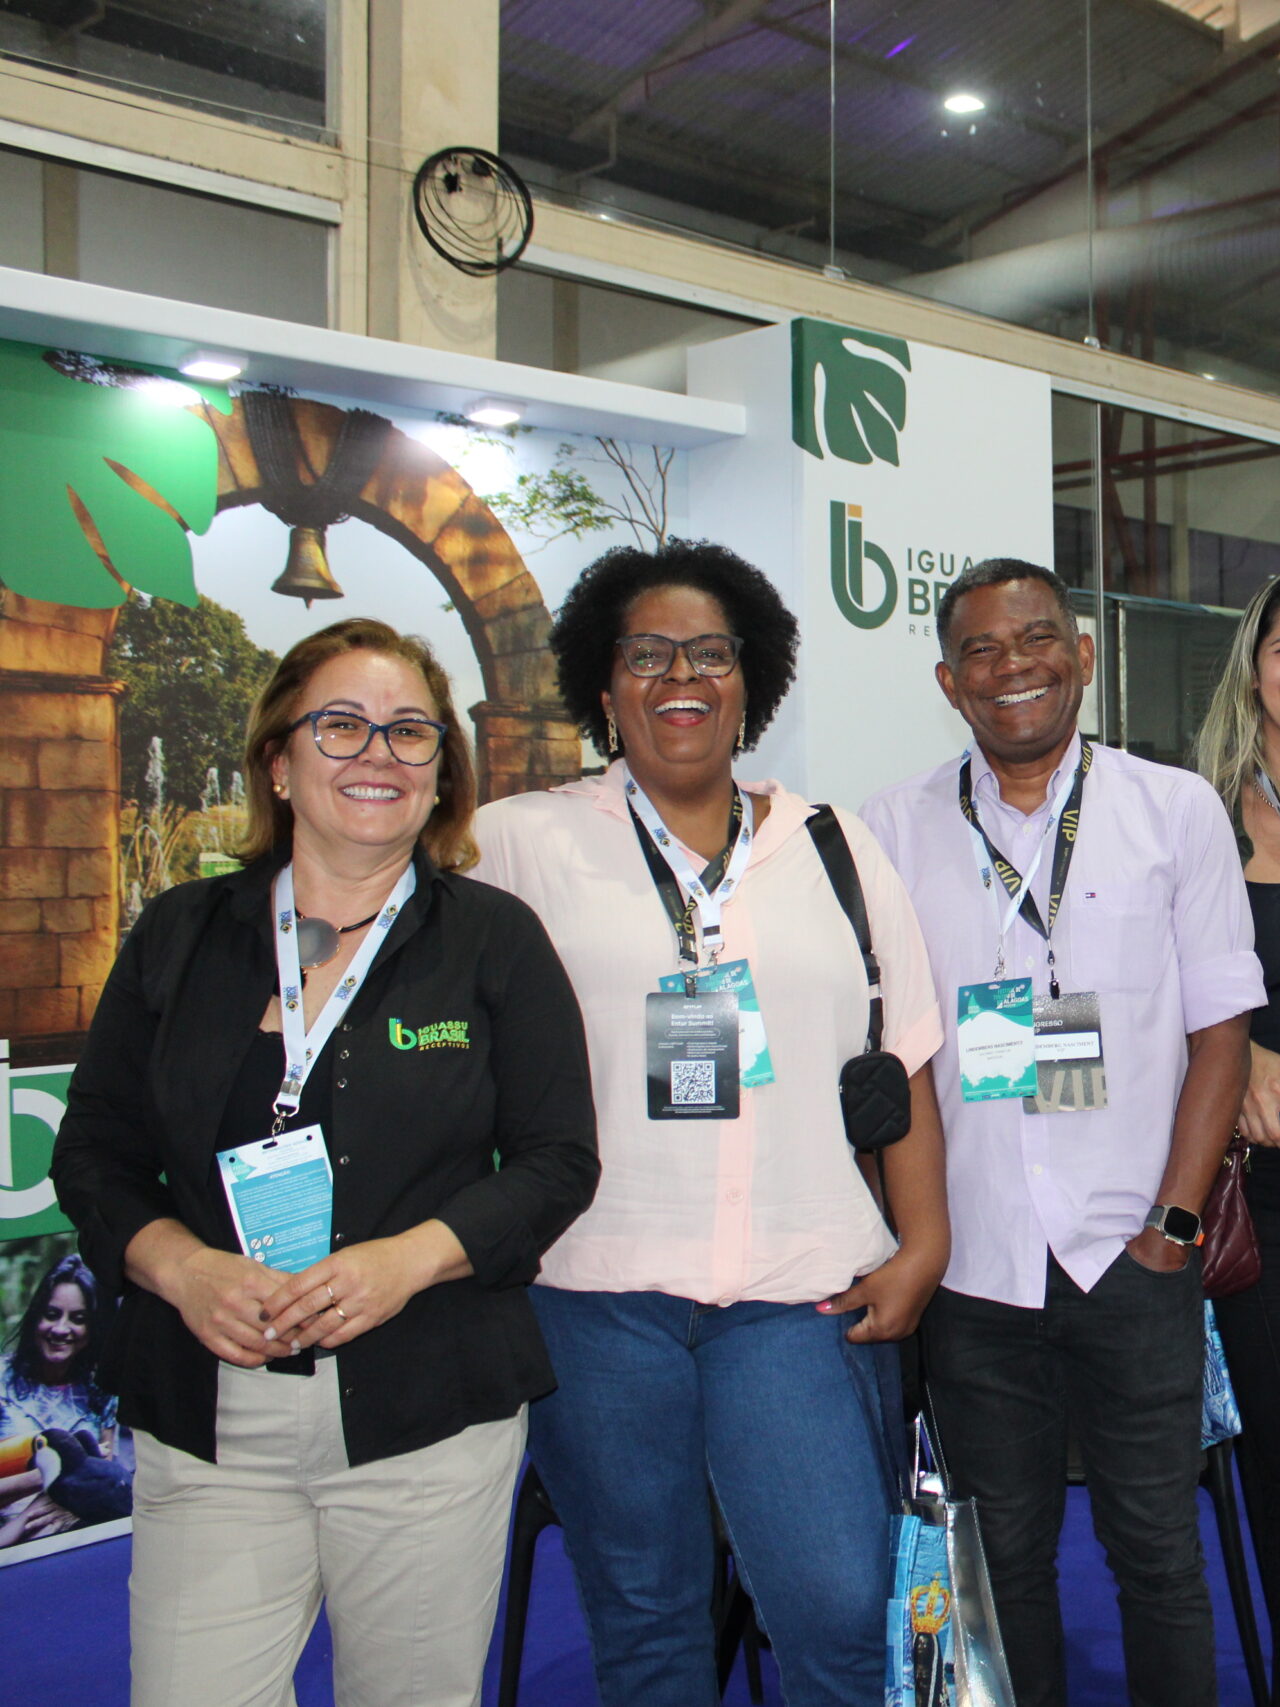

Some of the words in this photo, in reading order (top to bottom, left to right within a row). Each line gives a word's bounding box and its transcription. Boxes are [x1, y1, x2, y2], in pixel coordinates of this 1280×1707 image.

[907, 548, 973, 577] IGUA
[1082, 746, 1092, 772] VIP
[1062, 809, 1079, 842] VIP
[994, 860, 1022, 893] VIP
[418, 1021, 469, 1034] IGUASSU
[418, 1030, 470, 1046] BRASIL
